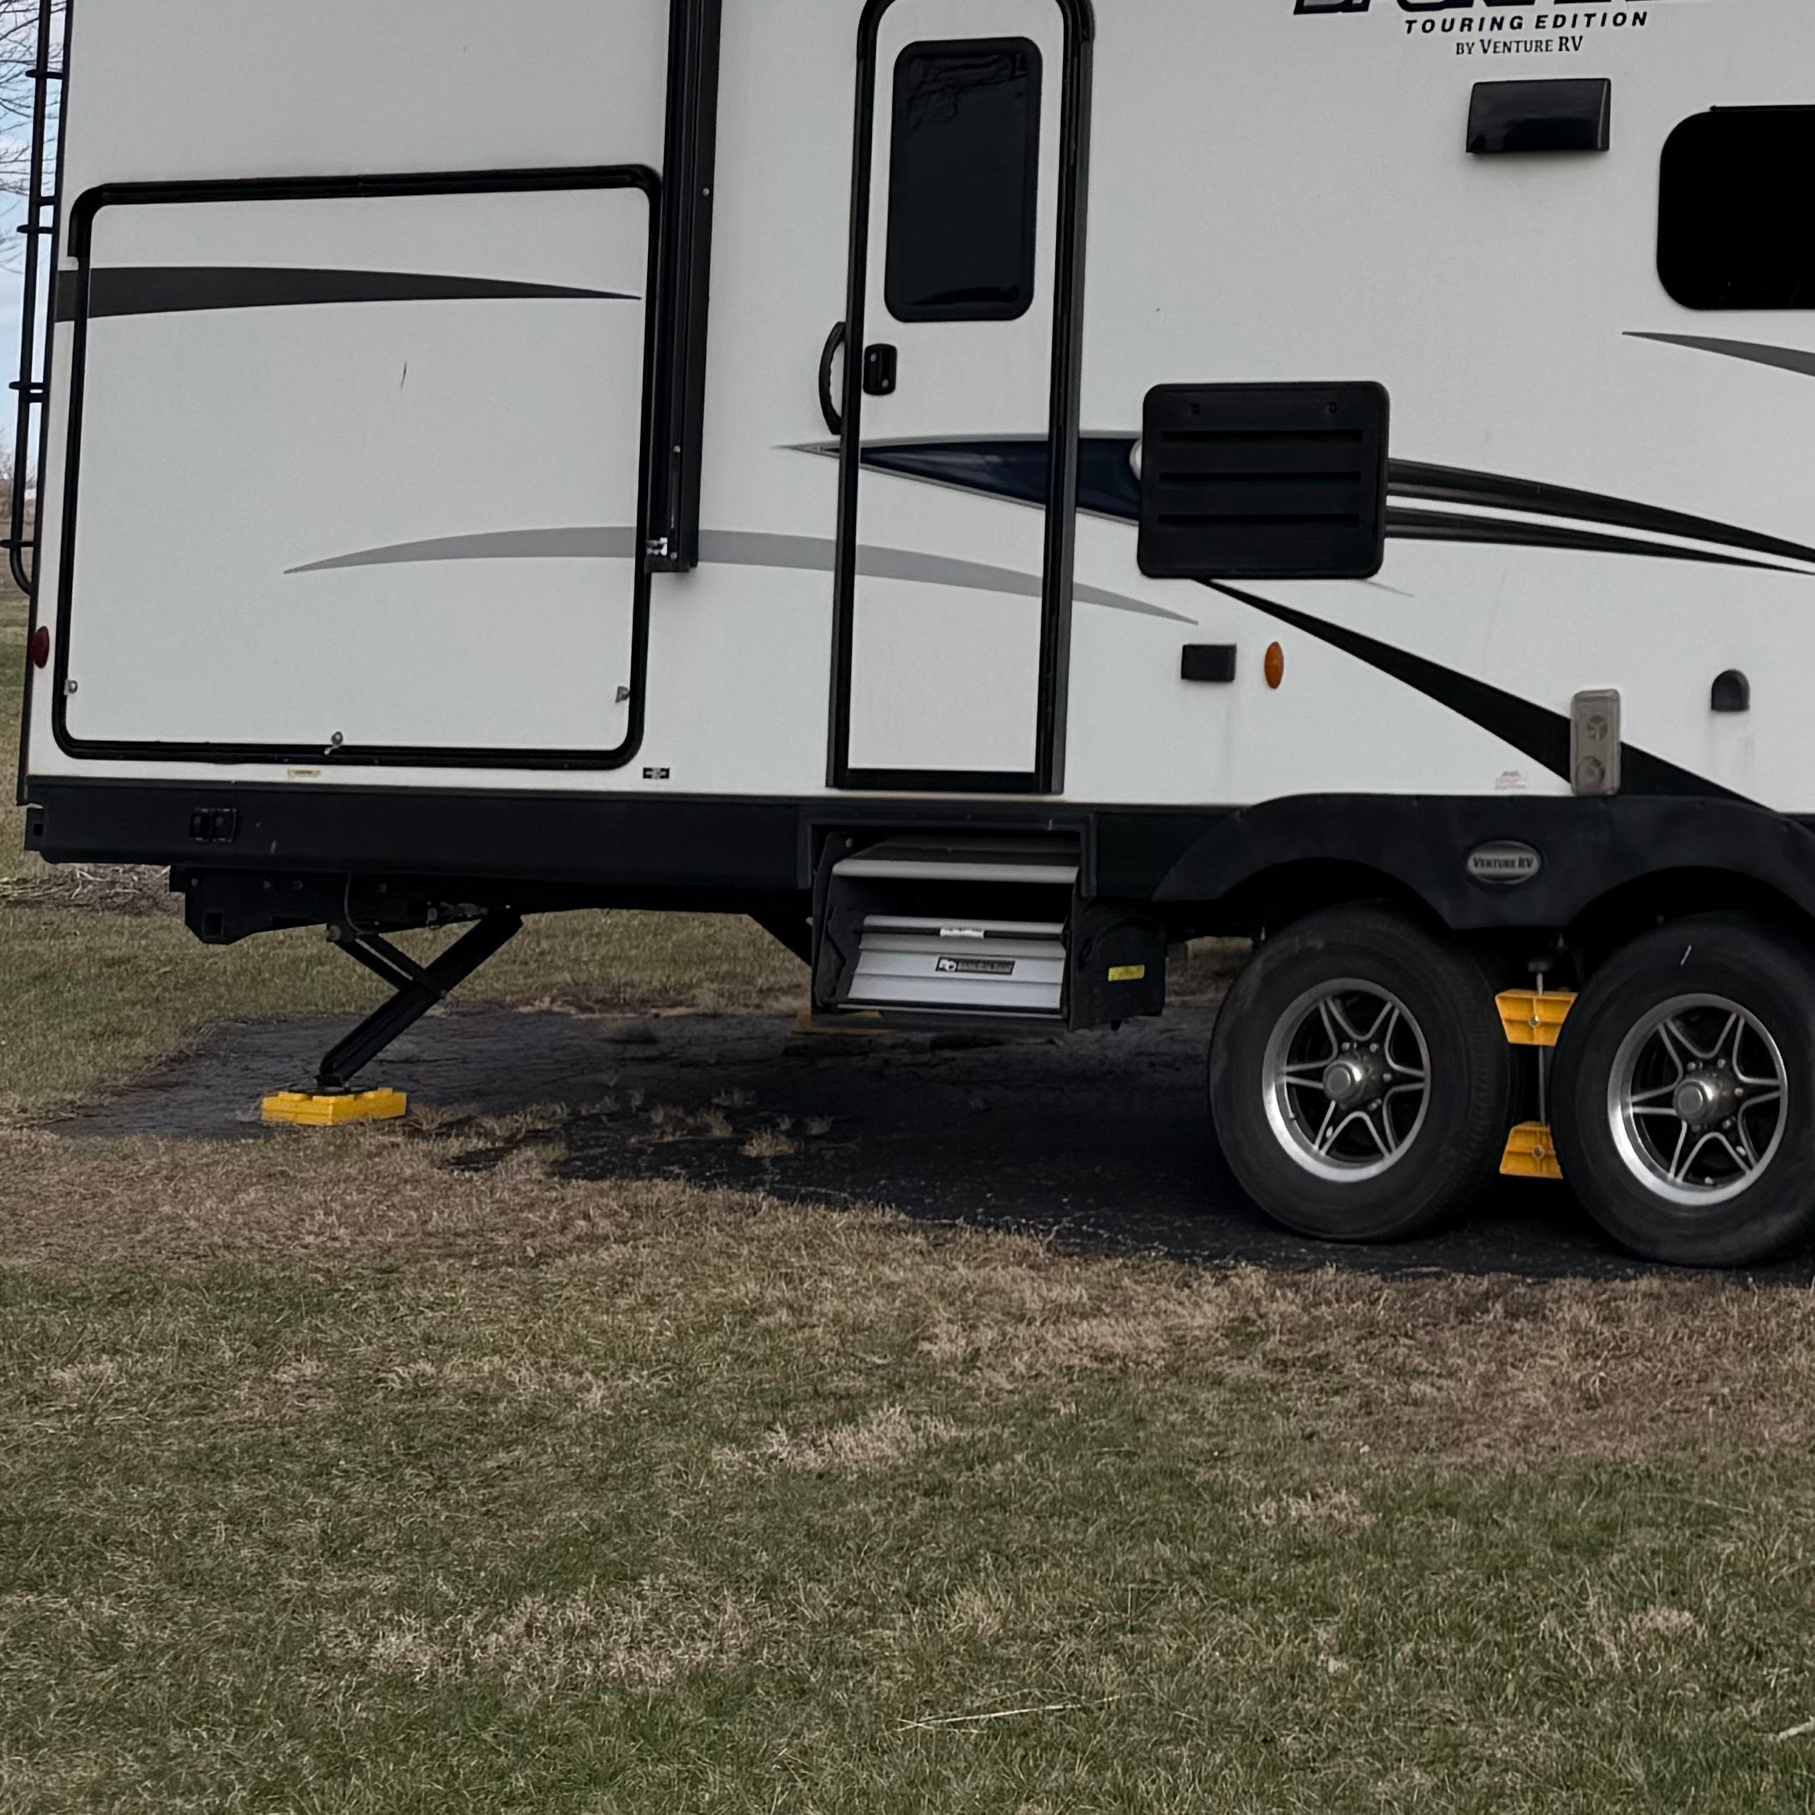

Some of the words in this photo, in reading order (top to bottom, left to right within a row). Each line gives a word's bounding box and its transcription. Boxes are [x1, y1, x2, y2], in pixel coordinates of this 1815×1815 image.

[1404, 15, 1524, 34] TOURING
[1535, 11, 1648, 30] EDITION
[1455, 41, 1476, 56] BY
[1558, 35, 1584, 52] RV
[1518, 857, 1533, 868] RV
